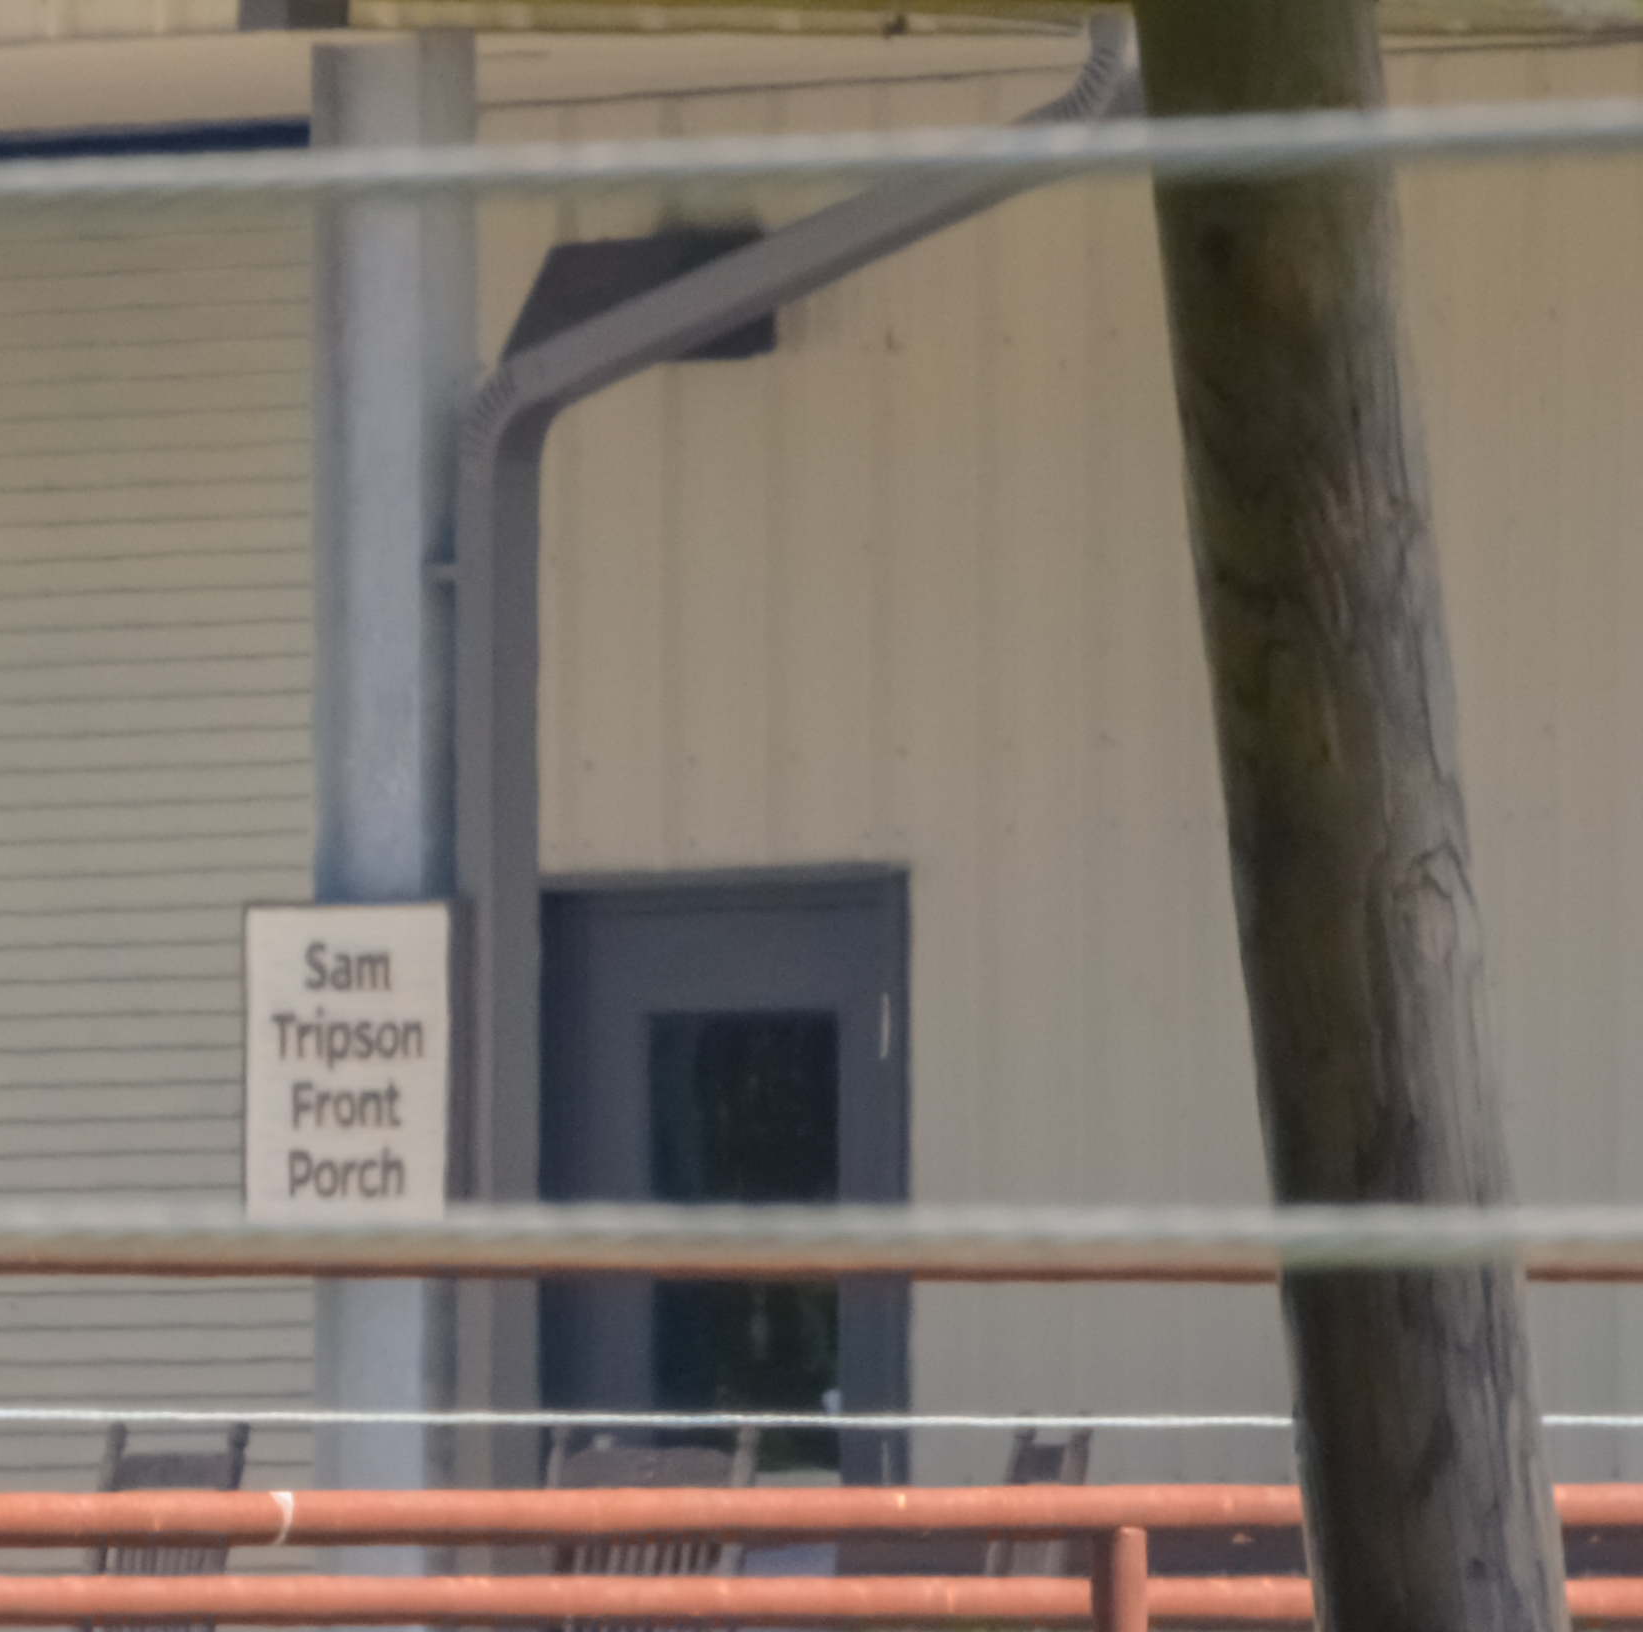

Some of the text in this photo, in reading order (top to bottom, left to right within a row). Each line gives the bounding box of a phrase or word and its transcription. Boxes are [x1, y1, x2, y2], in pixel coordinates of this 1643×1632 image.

[304, 941, 390, 991] Sam
[271, 1008, 424, 1068] Tripson
[291, 1080, 402, 1129] Front
[288, 1147, 405, 1198] Porch
